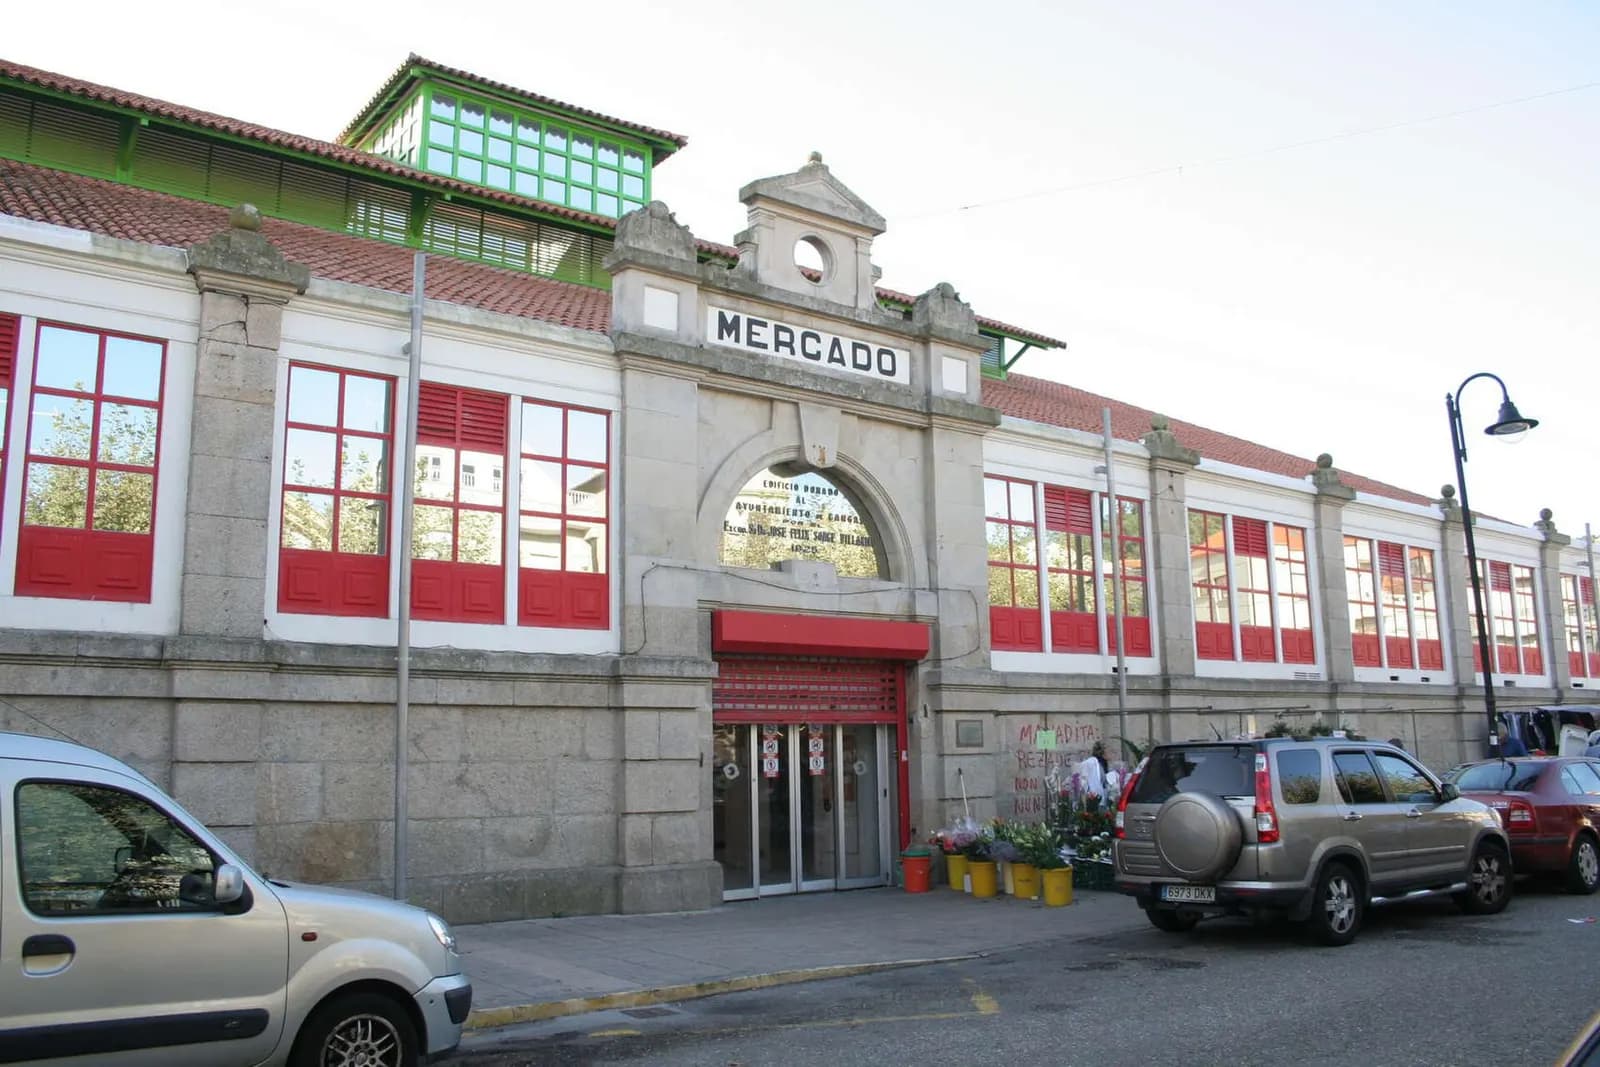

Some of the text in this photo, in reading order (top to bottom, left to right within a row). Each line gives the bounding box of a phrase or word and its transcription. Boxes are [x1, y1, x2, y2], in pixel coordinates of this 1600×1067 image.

[717, 310, 897, 377] MERCADO
[763, 480, 799, 491] EDIFICIO
[796, 496, 806, 504] AL
[736, 501, 811, 518] AYUNTAMIENTO
[1168, 887, 1191, 898] 6973
